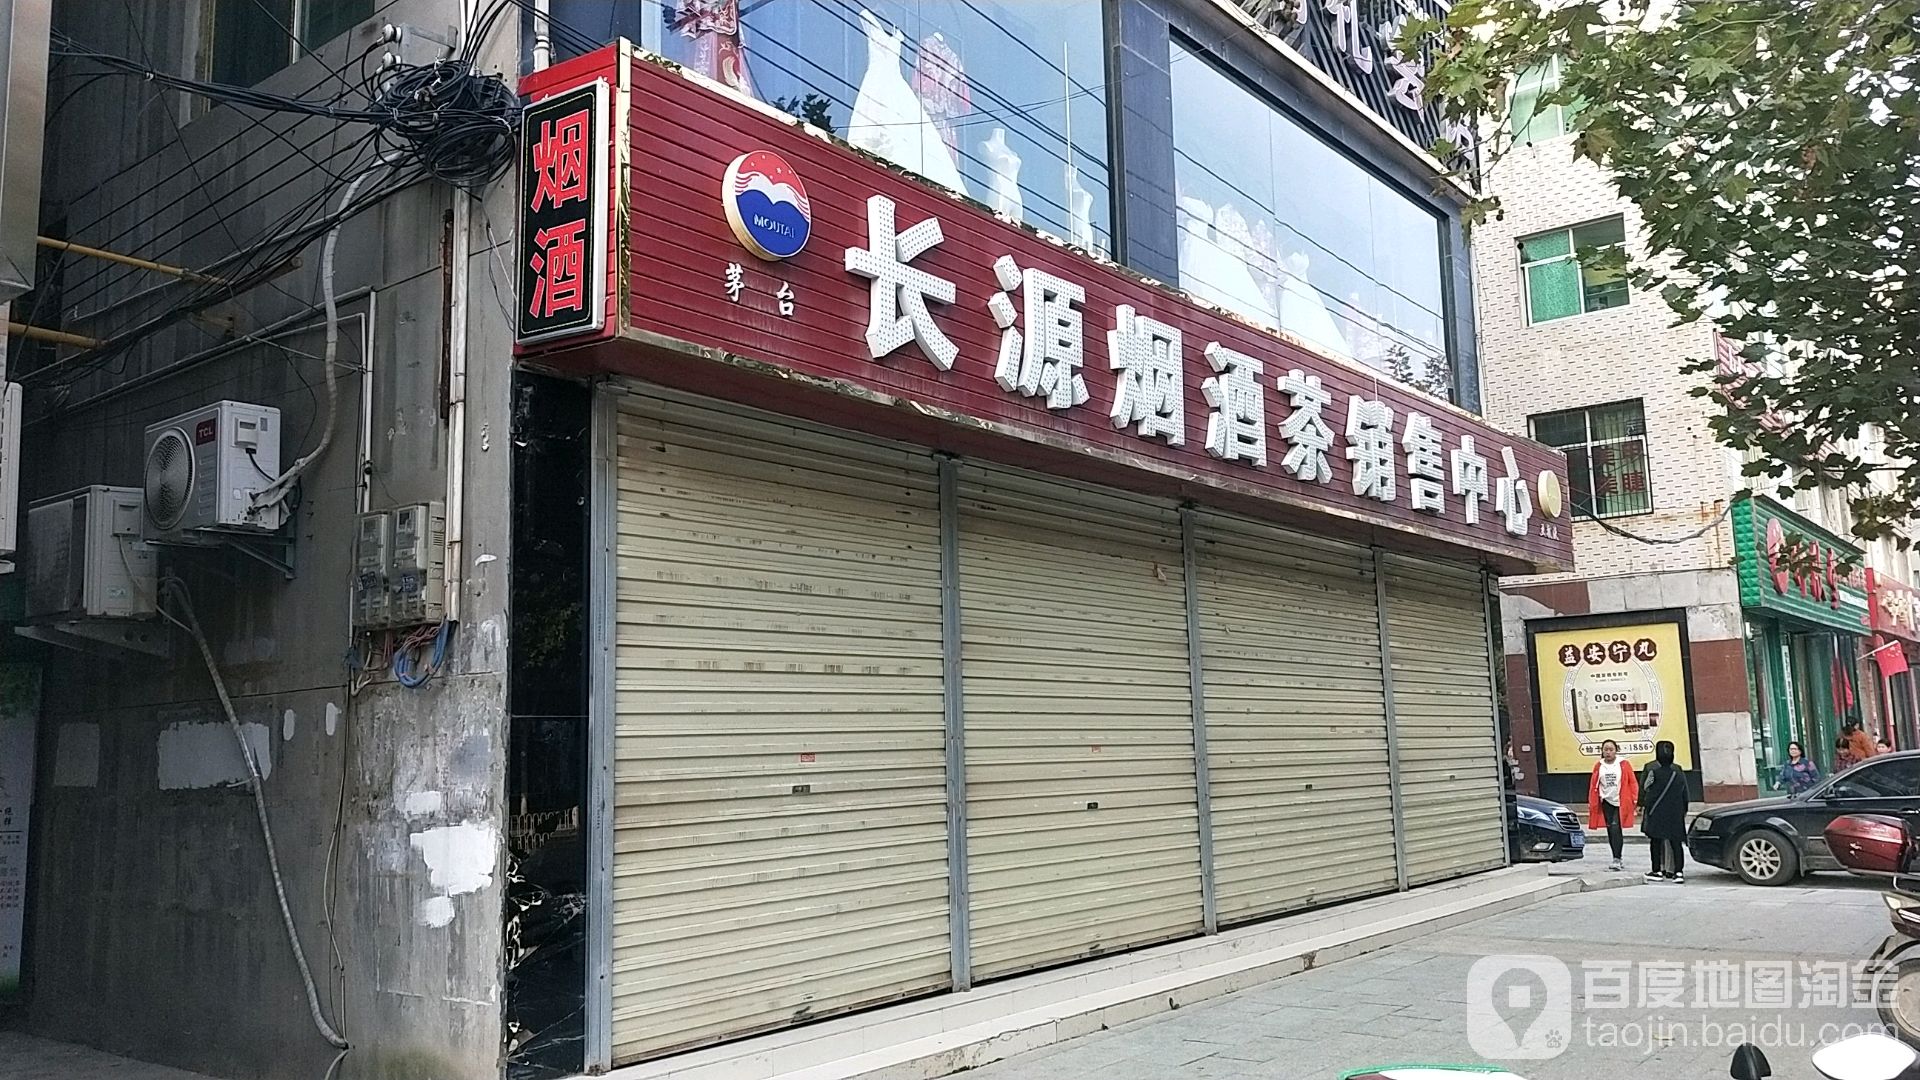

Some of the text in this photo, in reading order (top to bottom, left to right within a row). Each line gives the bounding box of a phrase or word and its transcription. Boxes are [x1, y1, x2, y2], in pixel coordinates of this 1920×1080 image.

[530, 108, 589, 319] 烟酒
[753, 214, 795, 238] MOUTAI
[724, 262, 795, 317] 茅台
[844, 195, 1533, 536] 长源烟酒茶销售中心
[199, 426, 214, 438] TCL
[1562, 640, 1656, 665] 益安宁丸
